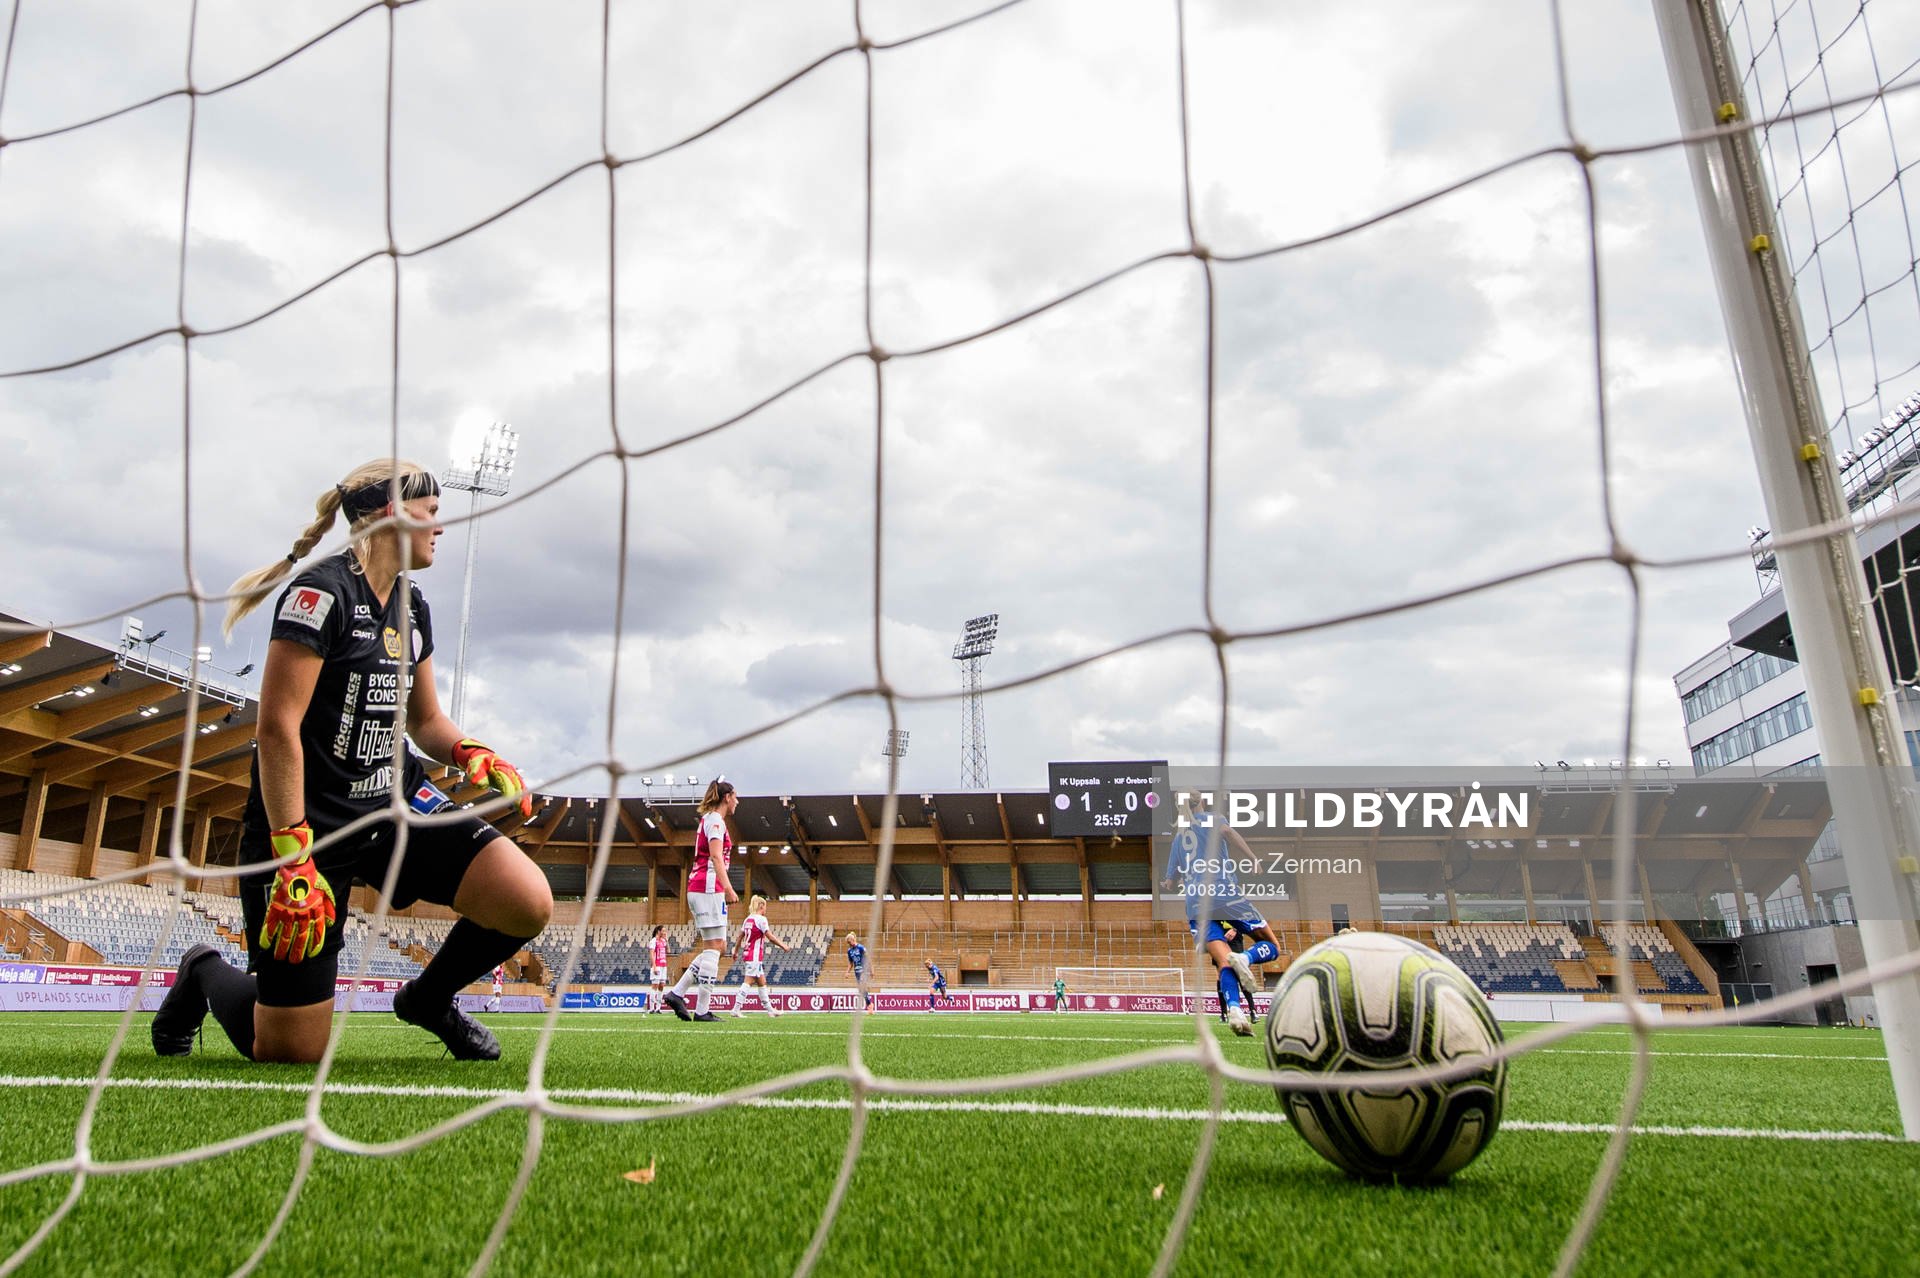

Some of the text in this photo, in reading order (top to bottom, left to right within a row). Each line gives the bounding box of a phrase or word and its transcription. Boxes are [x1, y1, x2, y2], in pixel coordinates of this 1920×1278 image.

[333, 671, 359, 760] HÖGBERGS
[1069, 777, 1100, 787] Uppsala
[1126, 776, 1148, 785] Örebro
[1080, 792, 1091, 812] 1
[1124, 791, 1138, 812] 0
[1094, 814, 1128, 827] 25:57
[16, 991, 111, 1003] UPPLANDS SCHAKT
[610, 996, 640, 1007] OBOS
[877, 998, 969, 1008] KLÖVERN KÖVERN
[1131, 1003, 1174, 1011] WELLNESS
